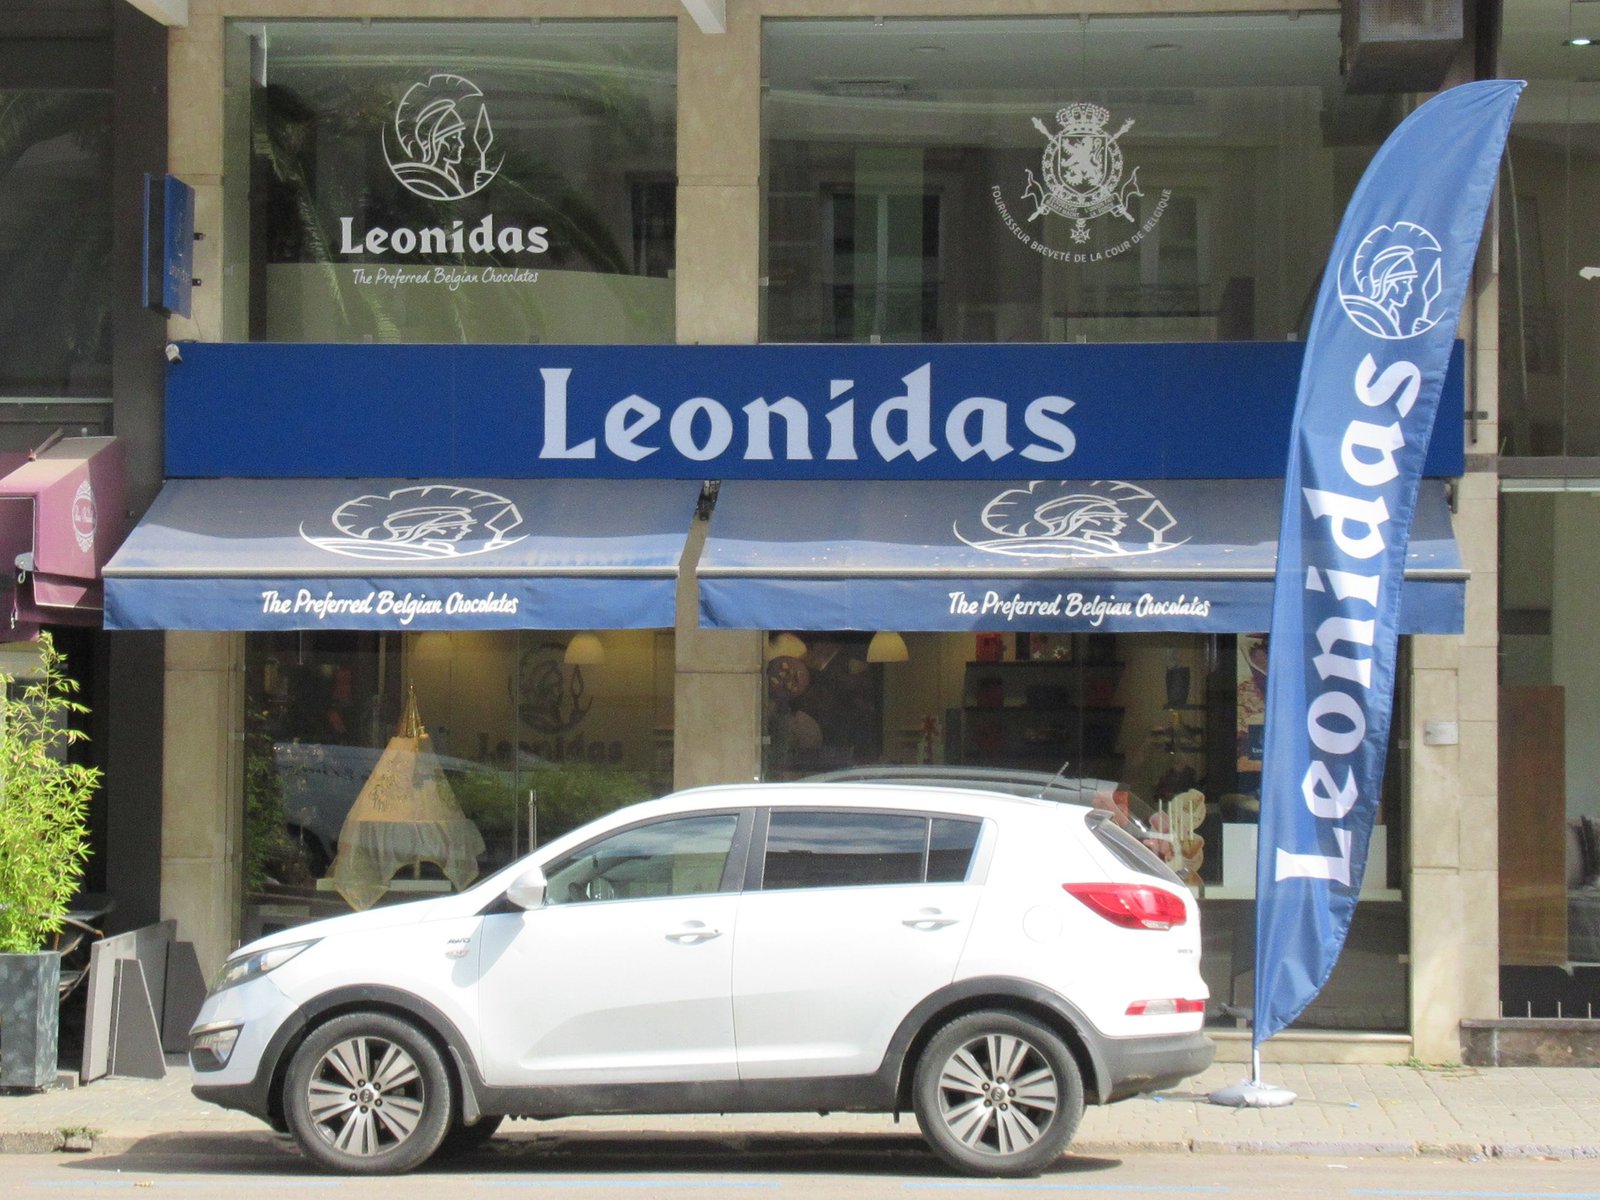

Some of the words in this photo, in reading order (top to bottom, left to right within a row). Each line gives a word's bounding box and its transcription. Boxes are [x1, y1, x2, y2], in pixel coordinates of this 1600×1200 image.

[339, 213, 550, 255] Leonidas
[991, 185, 1031, 245] FOURNISSEUR
[1030, 240, 1071, 262] BREVETÉ
[1074, 253, 1087, 263] DE
[1089, 251, 1103, 262] LA
[1105, 240, 1131, 258] COUR
[1131, 231, 1145, 244] DE
[1143, 188, 1172, 232] BELGIQUE
[352, 268, 372, 285] The
[375, 267, 431, 288] Preferred
[434, 267, 479, 291] Belgian
[481, 266, 539, 284] Chocolates
[538, 361, 1077, 463] Leonidas
[262, 590, 291, 614] The
[293, 589, 376, 619] Preferred
[376, 590, 442, 625] Belgian
[445, 591, 519, 615] Chocolates
[948, 591, 978, 615] The
[980, 590, 1061, 621] Preferred
[1064, 592, 1132, 626] Belgian
[1135, 593, 1211, 617] Chocolates
[1275, 352, 1421, 888] Leonidas
